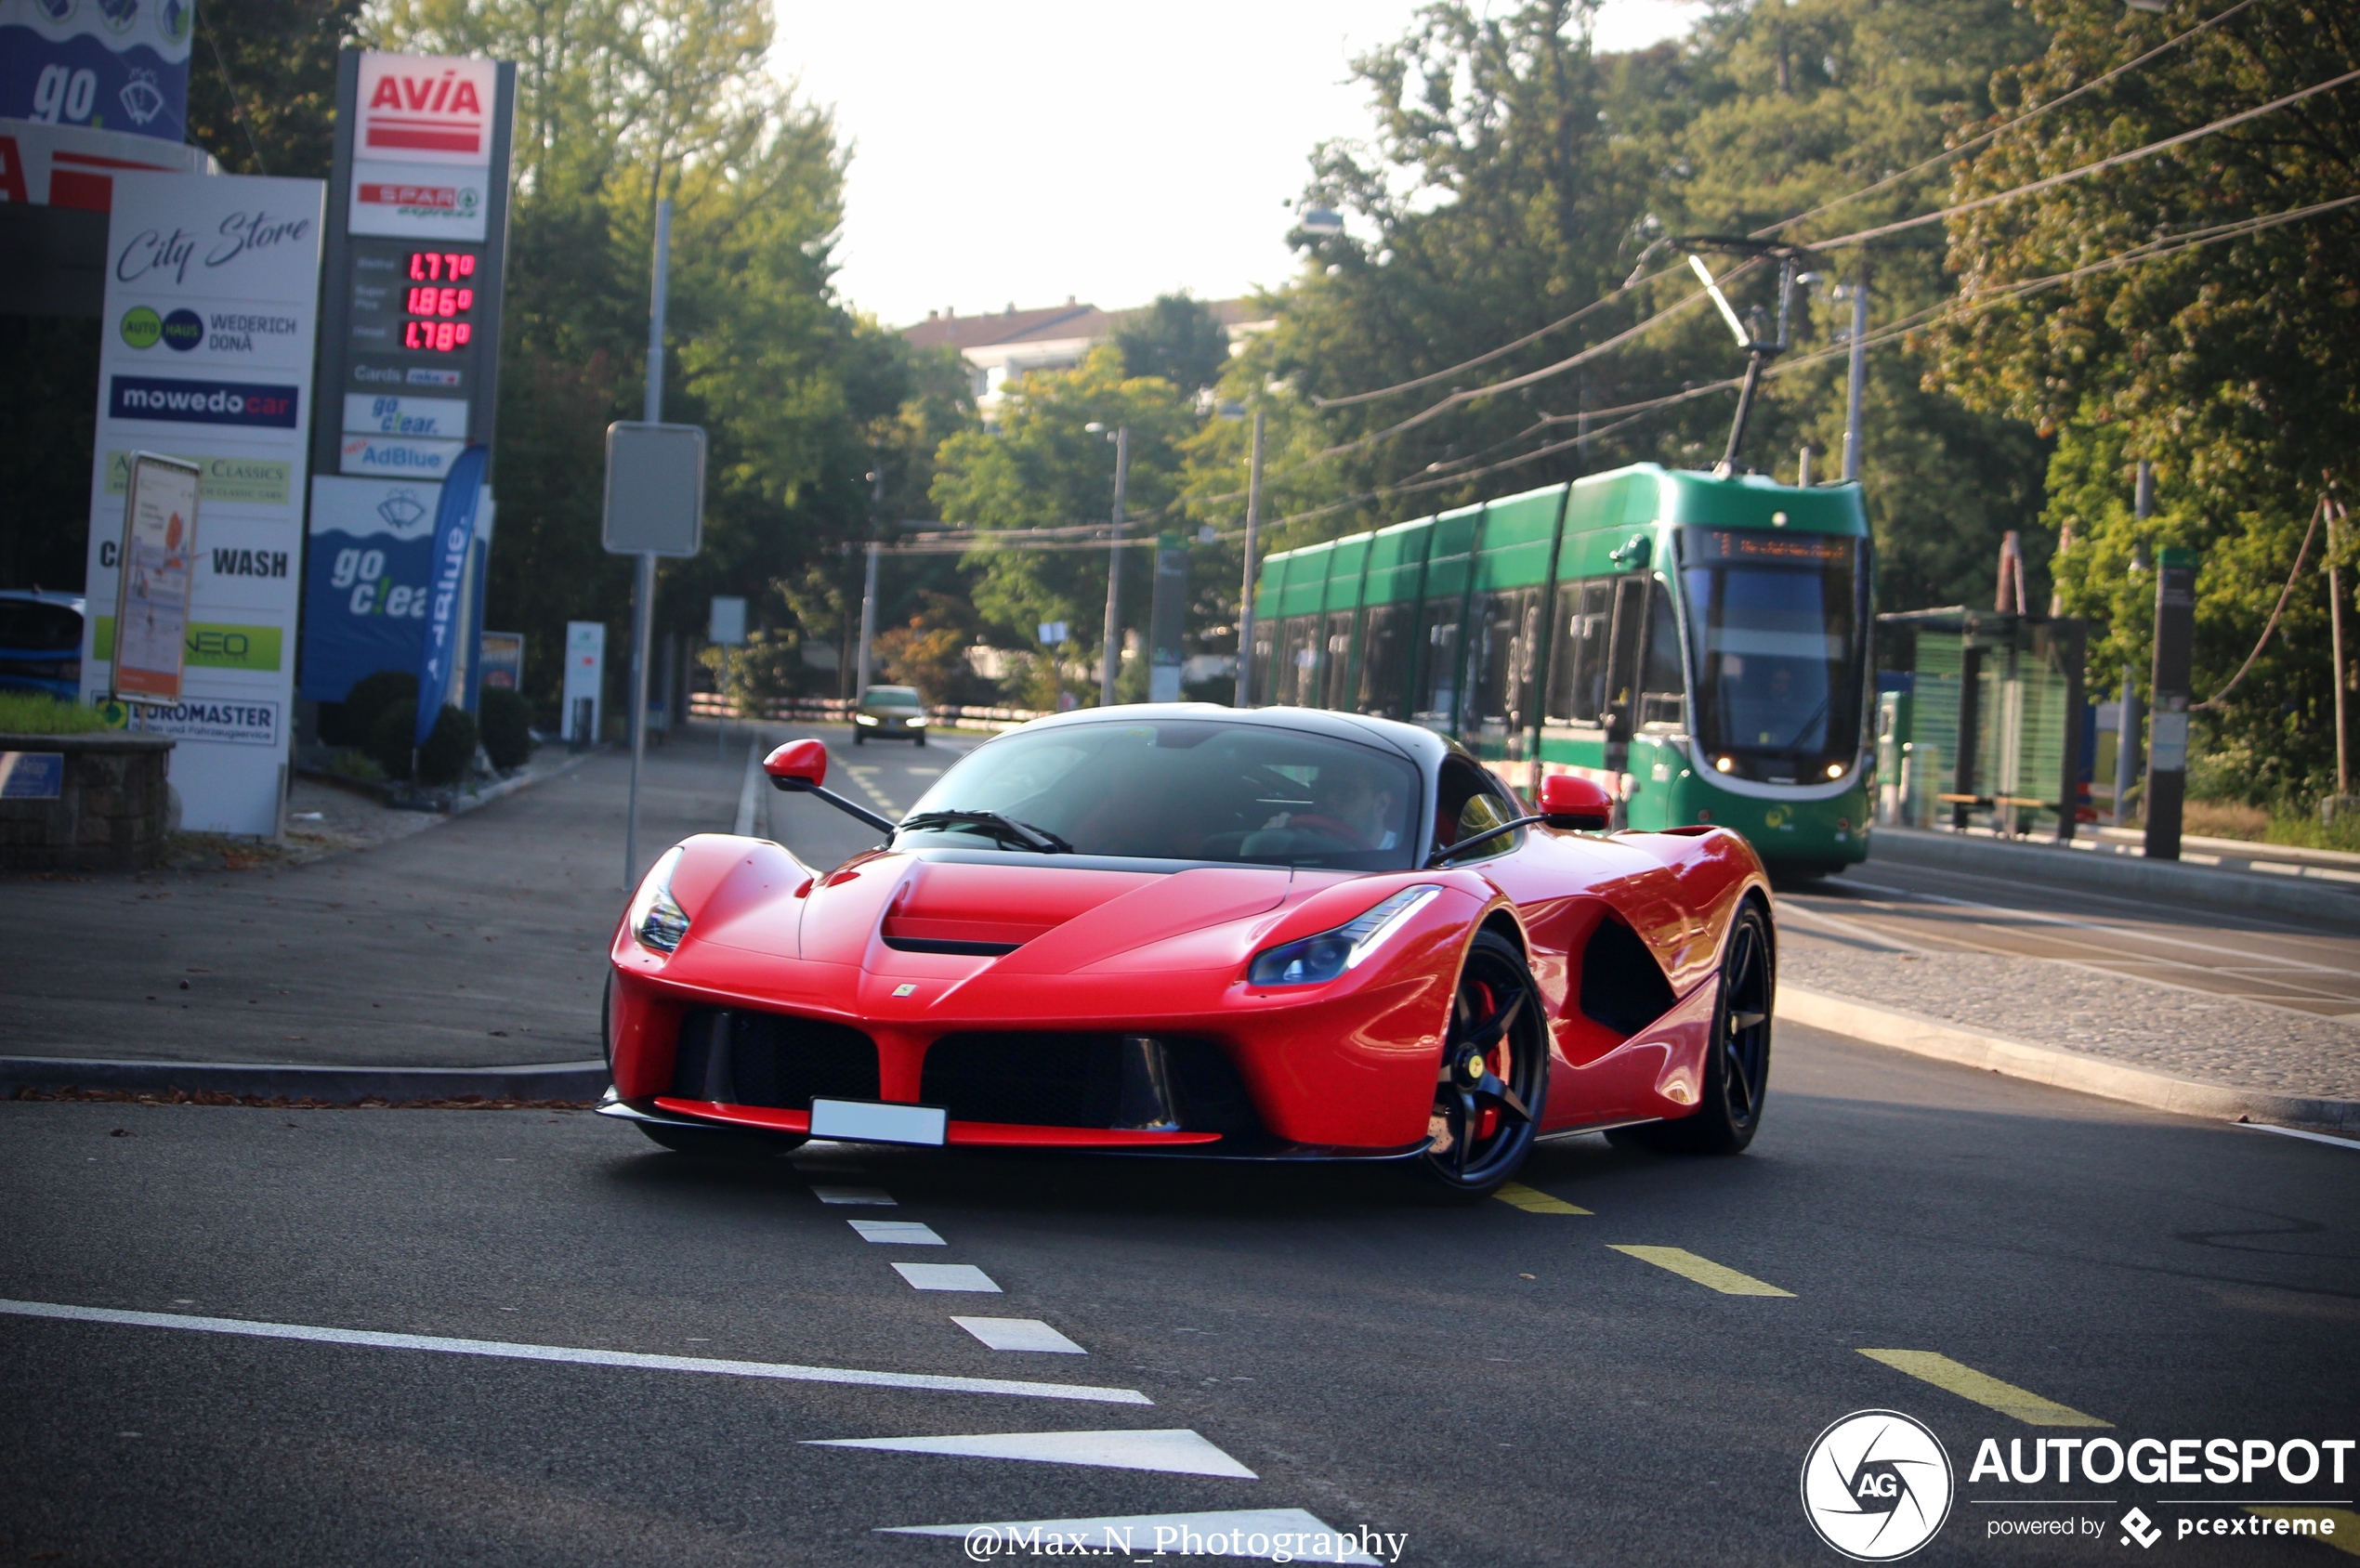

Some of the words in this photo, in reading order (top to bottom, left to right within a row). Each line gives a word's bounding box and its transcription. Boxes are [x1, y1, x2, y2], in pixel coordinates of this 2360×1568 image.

[379, 187, 455, 208] SPAR
[116, 228, 193, 284] City
[204, 211, 311, 268] Store
[125, 320, 158, 335] AUTO
[165, 323, 199, 338] HAUS
[210, 314, 297, 335] WEDERICH
[362, 446, 441, 467] AdBlue
[213, 547, 288, 578] WASH
[331, 547, 385, 589] go
